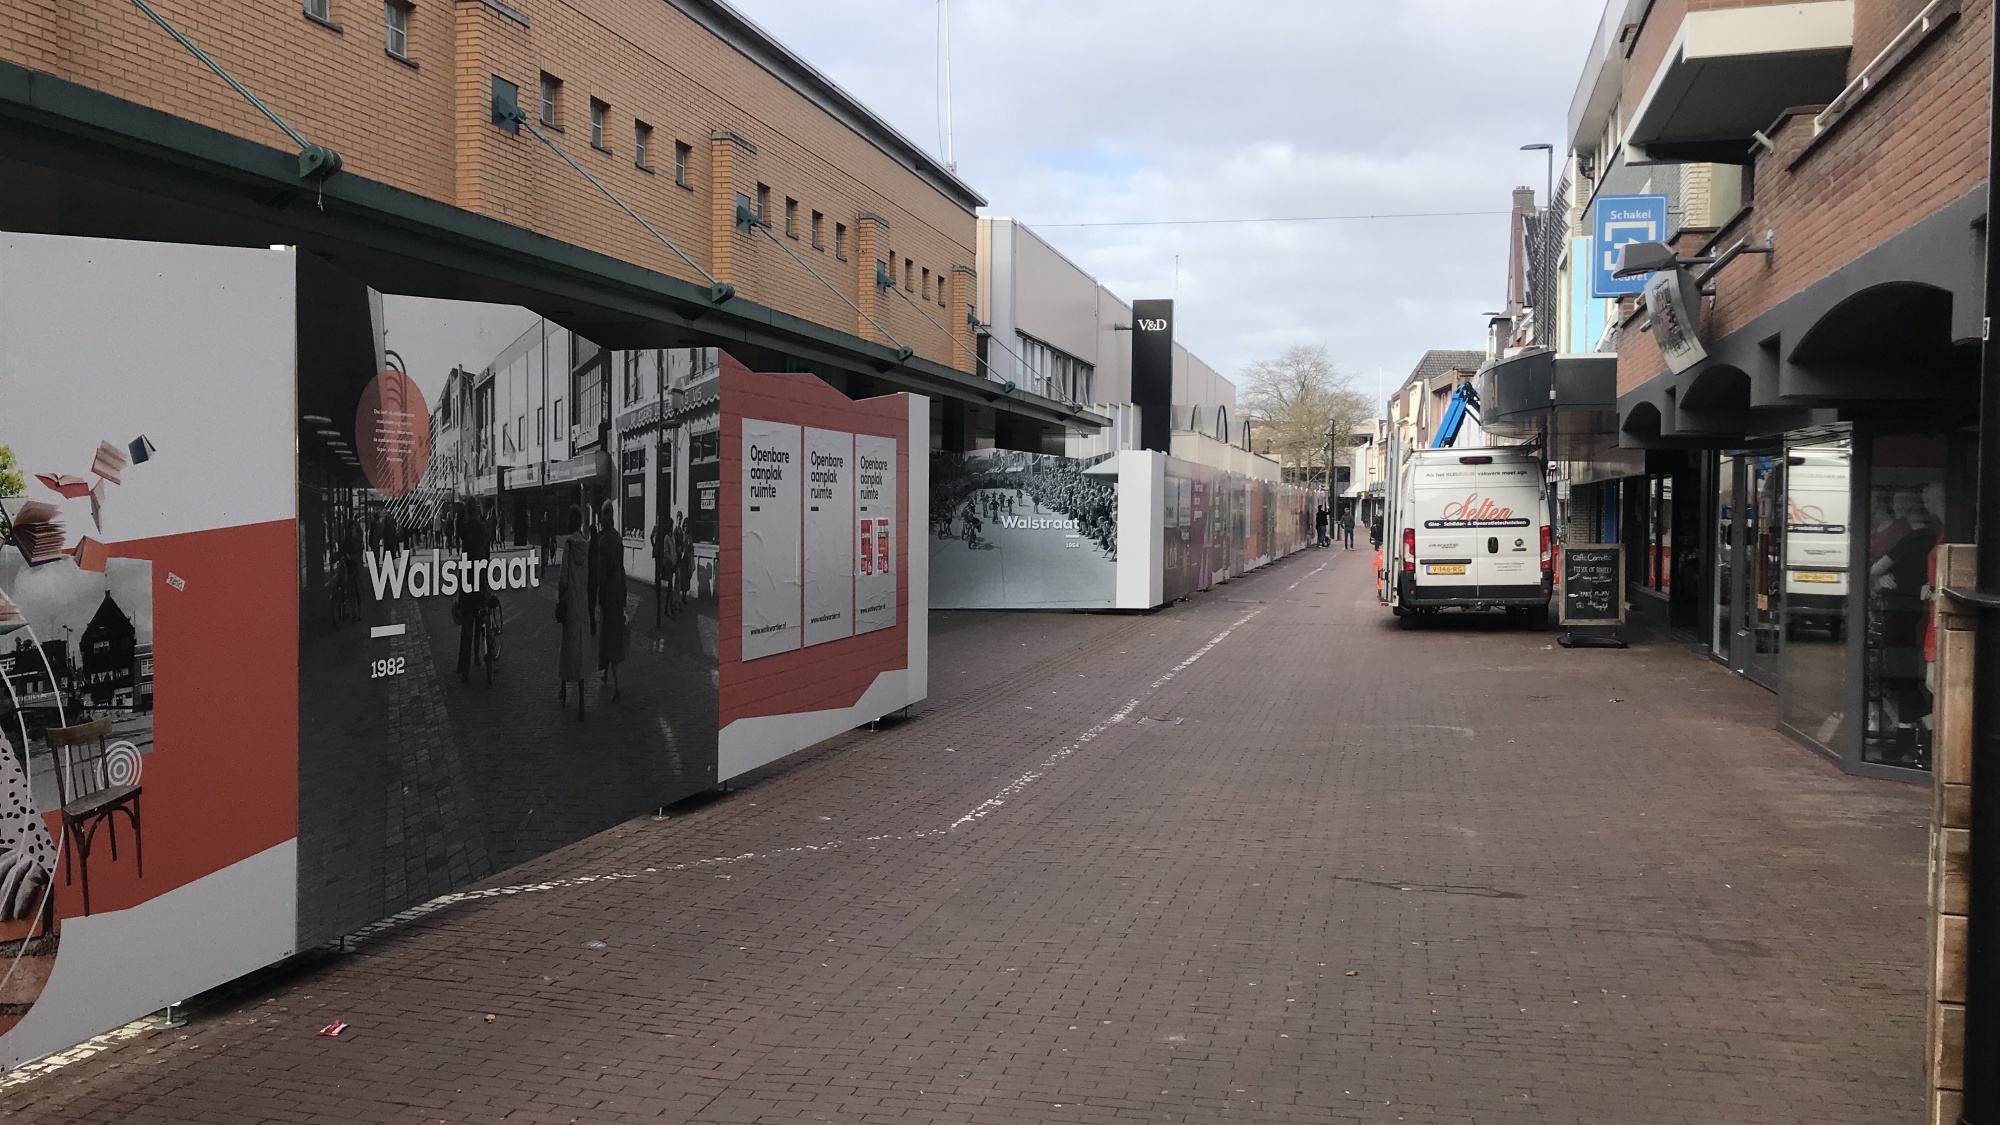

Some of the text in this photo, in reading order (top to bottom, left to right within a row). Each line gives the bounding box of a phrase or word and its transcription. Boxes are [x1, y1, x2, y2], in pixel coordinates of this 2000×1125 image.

[1610, 210, 1651, 220] Schakel
[1137, 318, 1167, 331] V&D
[751, 445, 790, 466] Openbare
[811, 450, 844, 470] Openbare
[860, 456, 888, 473] Openbare
[751, 465, 782, 485] aanplak
[811, 468, 838, 487] aanplak
[860, 472, 883, 488] aanplak
[751, 482, 777, 498] ruimte
[811, 484, 833, 500] ruimte
[860, 487, 879, 500] ruimte
[1440, 493, 1513, 521] Selten
[1001, 516, 1080, 529] Walstraat
[365, 549, 540, 601] Walstraat
[1432, 565, 1463, 573] V-146-RG
[371, 657, 405, 678] 1982
